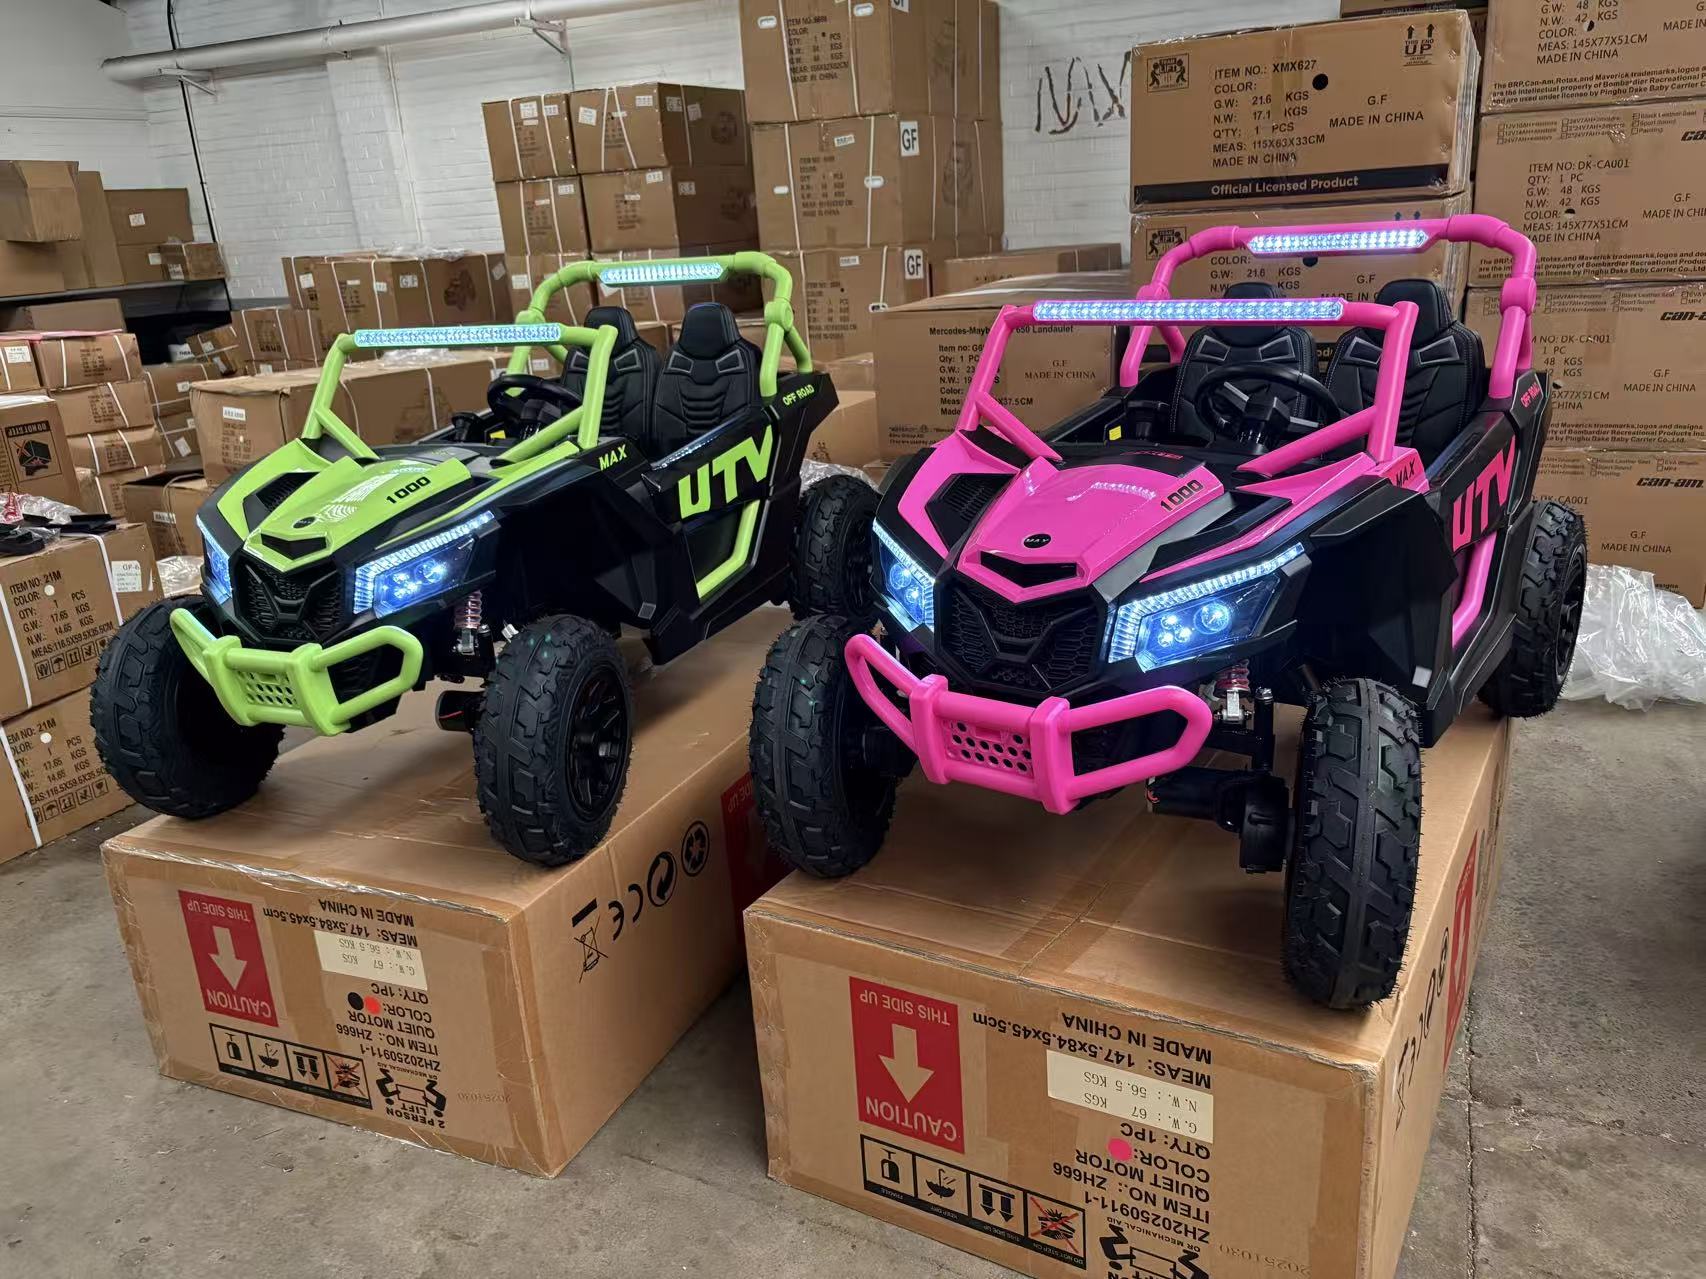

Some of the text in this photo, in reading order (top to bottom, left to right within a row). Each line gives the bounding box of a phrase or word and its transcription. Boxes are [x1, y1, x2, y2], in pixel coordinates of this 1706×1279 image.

[1541, 3, 1565, 14] G.W:
[1540, 10, 1618, 26] N.W: 42 KGS
[1662, 20, 1693, 31] MADE
[1538, 27, 1576, 40] COLOR:
[1404, 44, 1432, 55] UP
[1537, 33, 1648, 52] MEAS: 145X77X51CM
[1536, 49, 1619, 65] MADE IN CHINA
[1214, 68, 1240, 80] ITEM
[1272, 60, 1317, 73] XMX627
[1214, 81, 1257, 94] COLOR:
[1213, 90, 1310, 109] G.W: 21.6 KGS
[1213, 114, 1237, 125] N.W:
[1284, 106, 1308, 117] KGS
[1329, 110, 1424, 128] MADE IN CHINA
[1271, 122, 1295, 133] PCS
[901, 128, 918, 152] GF
[1212, 141, 1247, 153] MEAS:
[1212, 152, 1297, 168] MADE IN CHINA
[1529, 159, 1631, 173] ITEM NO: DK-CA001
[1211, 176, 1359, 196] Official Licensed Product
[1527, 173, 1584, 186] QTY: PC
[1526, 184, 1600, 197] G.W: 48 KGS
[1525, 196, 1600, 209] N.W: 42 KGS
[1523, 209, 1560, 221] COLOR:
[1642, 208, 1684, 219] MADE IN
[1522, 219, 1629, 232] MEAS: 145X77X51CM
[1554, 231, 1601, 242] IN CHINA
[906, 253, 921, 276] GF
[1210, 269, 1234, 279] G.W:
[1277, 266, 1301, 277] KGS
[1277, 280, 1300, 290] KGS
[1032, 325, 1074, 334] Landaulet
[1560, 334, 1610, 344] DK-CA001
[938, 344, 956, 352] Item
[1543, 357, 1583, 366] 48 KGS
[1024, 371, 1097, 380] MADE CHINA
[1563, 368, 1582, 377] KGS
[782, 384, 816, 407] OFF ROAD
[1623, 383, 1696, 392] MADE IN CHINA
[940, 408, 961, 416] Made
[598, 444, 629, 472] MAX
[678, 424, 773, 519] UTV
[386, 475, 432, 504] 1000
[1160, 479, 1206, 512] 1000
[1451, 434, 1517, 553] UTV
[1600, 543, 1672, 553] MADE IN CHINA
[9, 570, 62, 595] ITEM 21M
[13, 591, 40, 607] COLOR:
[71, 590, 86, 602] PCS
[75, 602, 90, 615] KGS
[79, 614, 95, 627] KGS
[37, 718, 57, 731] 21M
[66, 735, 82, 748] PCS
[70, 747, 87, 760] KGS
[73, 759, 91, 772] KGS
[186, 900, 250, 923] THIS SIDE UP
[317, 898, 415, 928] MADE IN CHINA
[263, 908, 418, 948] MEAS: 147.5x84.5x45.5cm
[338, 938, 381, 955] 56.5 KGS
[341, 953, 384, 970] 67 KGS
[370, 983, 429, 1005] QTY: 1PC
[206, 988, 272, 1018] CAUTION
[859, 989, 951, 1026] THIS SIDE UP
[382, 1003, 432, 1024] COLOR:
[347, 1010, 435, 1039] QUIET MOTOR
[336, 1024, 438, 1056] ITEM NO.: ZH666
[1061, 1013, 1212, 1065] MADE IN CHINA
[359, 1044, 441, 1072] ZH20250911-1
[972, 1013, 1212, 1090] MEAS: 147.5x84.5x45.5cm
[388, 1063, 427, 1078] MECHANICAL
[1083, 1071, 1198, 1113] N.W.: 56.5 KGS
[386, 1107, 435, 1126] PERSON
[400, 1103, 427, 1116] LIFT
[1083, 1092, 1198, 1134] G.W.: 67 KGS
[865, 1096, 957, 1142] CAUTION
[1119, 1122, 1211, 1160] QTY: 1PC
[1132, 1149, 1210, 1182] COLOR:
[1075, 1149, 1210, 1202] QUIET MOTOR
[1052, 1161, 1210, 1224] ITEM NO.: ZH666
[1083, 1191, 1211, 1244] ZH20250911-1
[1124, 1221, 1185, 1249] MECHANICAL
